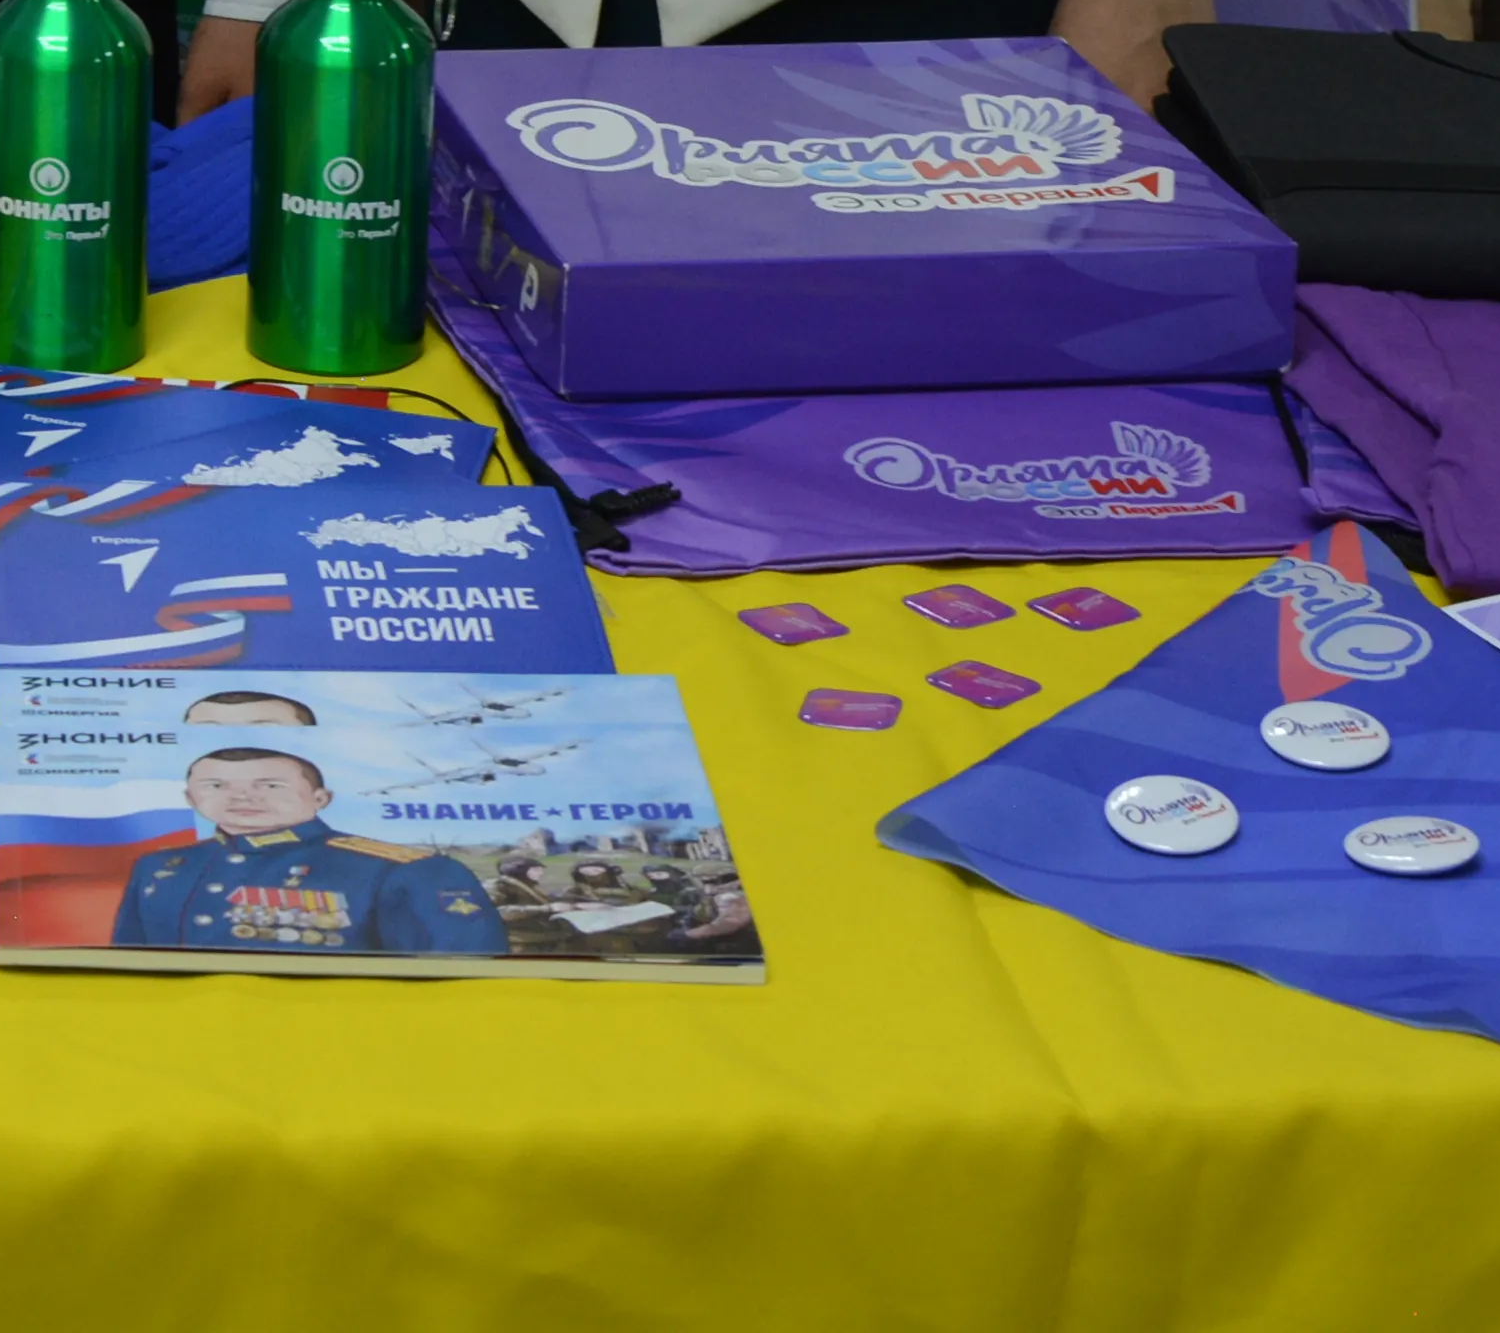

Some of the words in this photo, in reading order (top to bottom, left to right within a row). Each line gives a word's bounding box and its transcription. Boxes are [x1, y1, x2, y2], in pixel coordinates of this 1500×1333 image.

[522, 104, 1018, 173] Орлята
[282, 192, 400, 221] ЮННАТЫ
[825, 192, 924, 212] Это
[938, 183, 1132, 210] Первые
[851, 440, 1150, 494] Орлята
[1042, 504, 1100, 519] Это
[1107, 501, 1220, 518] Первые
[318, 559, 388, 582] МЫ
[323, 586, 540, 611] ГРАЖДАНЕ
[330, 616, 494, 643] РОССИИ!
[381, 801, 538, 822] ЗНАНИЕ
[570, 801, 694, 821] ГЕРОИ
